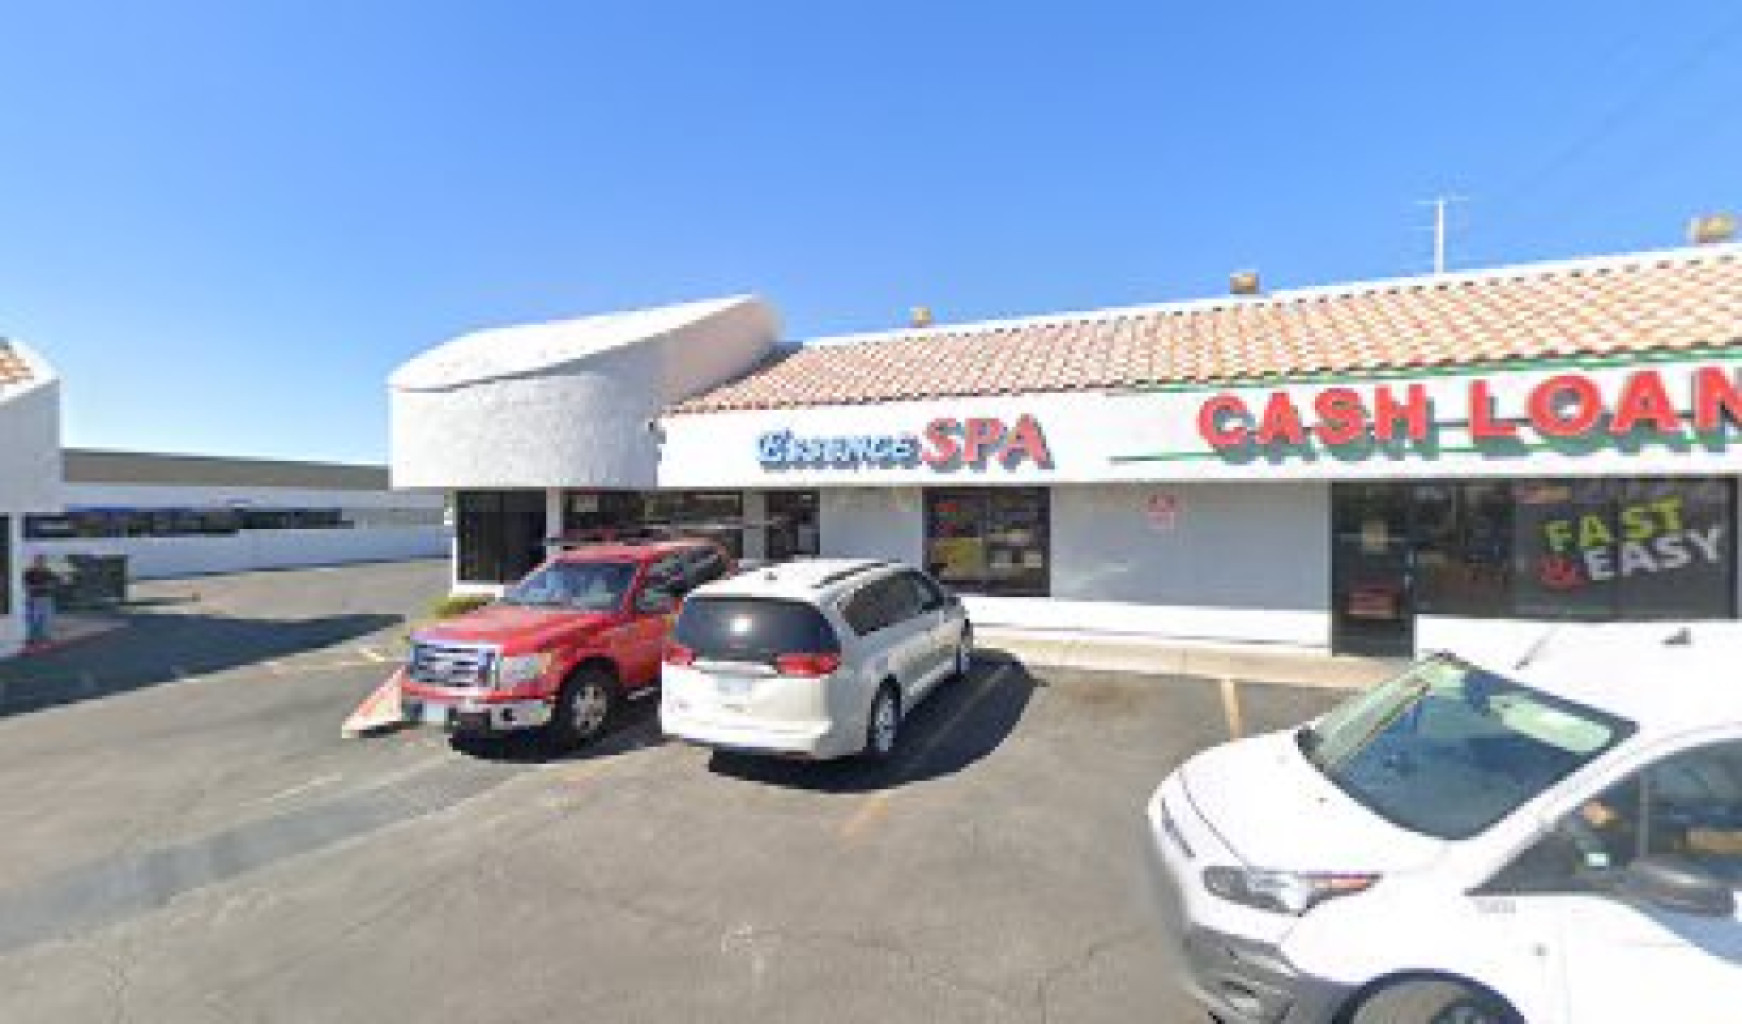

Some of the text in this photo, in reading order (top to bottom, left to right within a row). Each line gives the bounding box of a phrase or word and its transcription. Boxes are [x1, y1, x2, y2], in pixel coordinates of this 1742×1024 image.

[1197, 366, 1742, 446] CASH LOAN
[923, 413, 1053, 468] SPA
[1541, 495, 1684, 552] FAST
[1583, 525, 1723, 581] EASY
